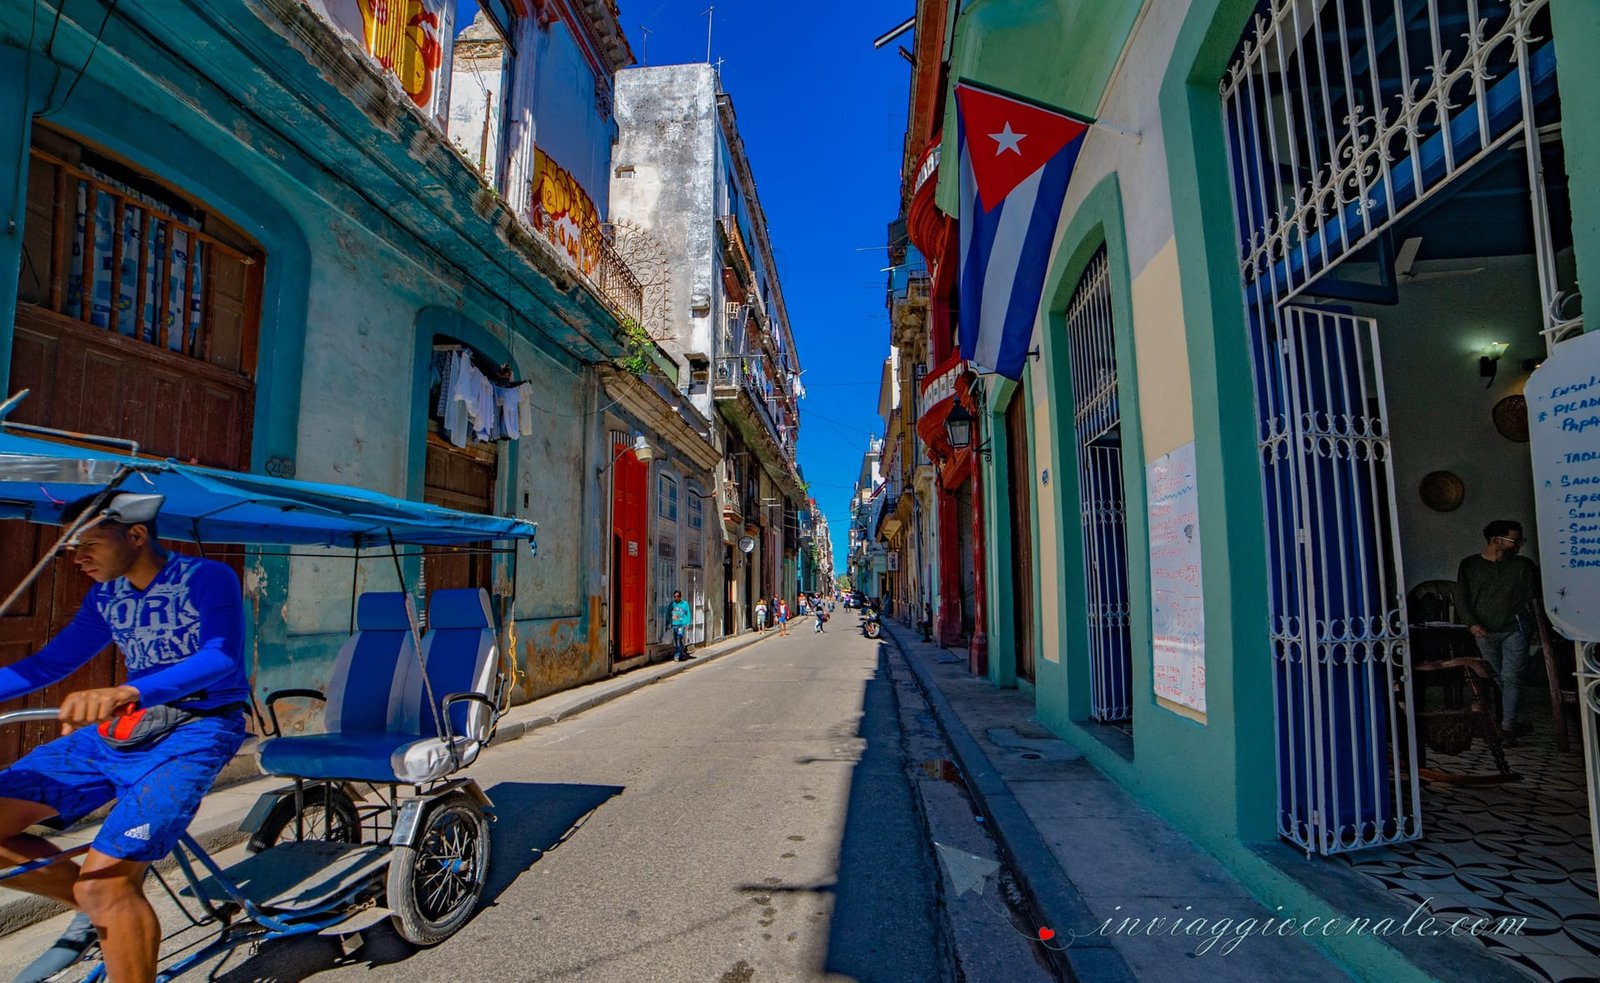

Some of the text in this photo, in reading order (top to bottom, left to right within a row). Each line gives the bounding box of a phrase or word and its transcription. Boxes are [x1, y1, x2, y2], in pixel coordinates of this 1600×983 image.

[1550, 376, 1600, 399] ENSAL
[1564, 451, 1600, 464] TABL
[1568, 508, 1600, 519] SAN
[1568, 522, 1600, 533] SAN
[96, 591, 201, 630] YORK
